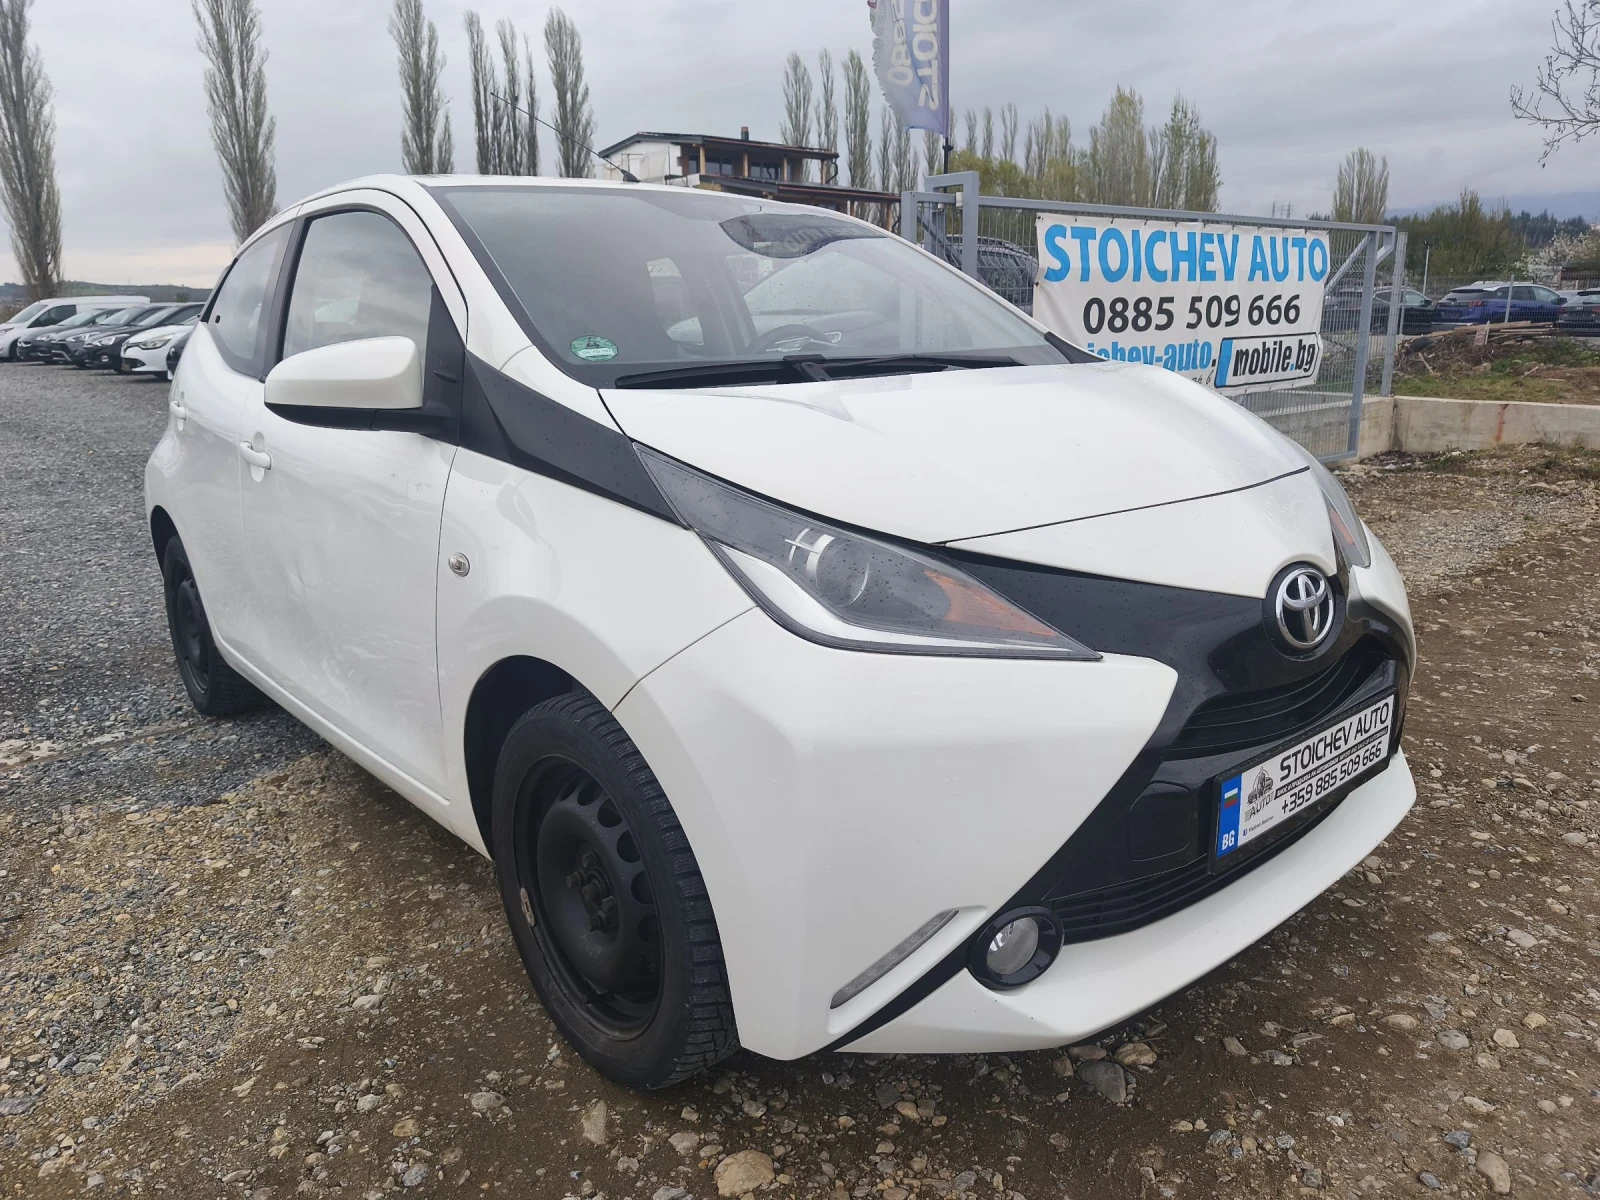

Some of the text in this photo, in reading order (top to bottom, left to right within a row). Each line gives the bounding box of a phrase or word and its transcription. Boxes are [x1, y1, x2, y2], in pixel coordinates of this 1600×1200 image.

[1044, 224, 1328, 283] STOICHEV AUTO
[1083, 294, 1300, 334] 0885 509 666
[1232, 339, 1315, 376] mobile.bg
[1280, 721, 1353, 782] STOICHEV
[1354, 702, 1389, 740] AUTO
[1282, 741, 1382, 814] +359 885 509 666
[1222, 829, 1235, 851] BG
